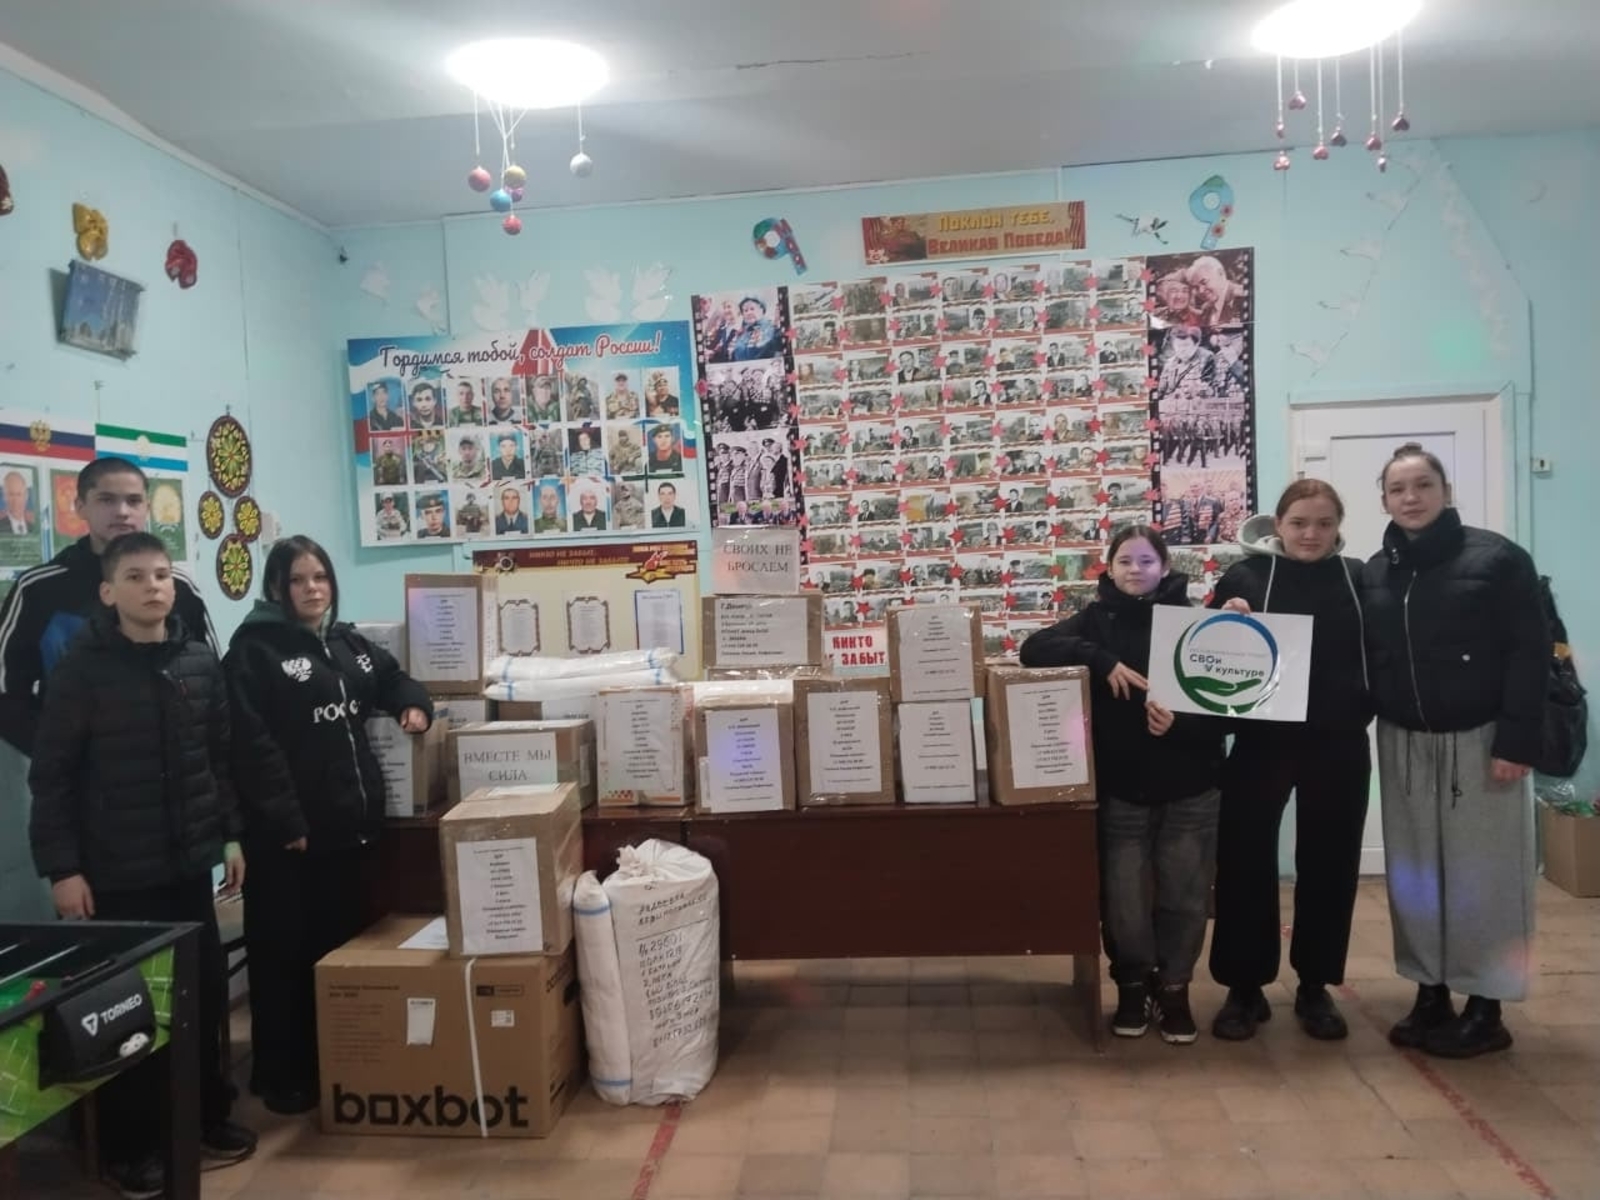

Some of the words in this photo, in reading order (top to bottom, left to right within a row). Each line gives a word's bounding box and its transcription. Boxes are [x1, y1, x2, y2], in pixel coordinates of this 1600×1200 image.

[467, 340, 524, 363] тобой,
[595, 330, 663, 358] России!
[723, 545, 769, 555] СВОИХ
[775, 545, 791, 555] НЕ
[728, 562, 788, 573] БРОСАЕМ
[832, 635, 873, 650] НИКТО
[841, 652, 885, 666] ЗАБЫТ
[1215, 667, 1265, 677] культуре
[464, 751, 521, 764] ВМЕСТЕ
[527, 750, 551, 762] МЫ
[489, 769, 528, 782] СИЛА
[100, 994, 142, 1024] TORNEO
[333, 1083, 529, 1129] boxbot
